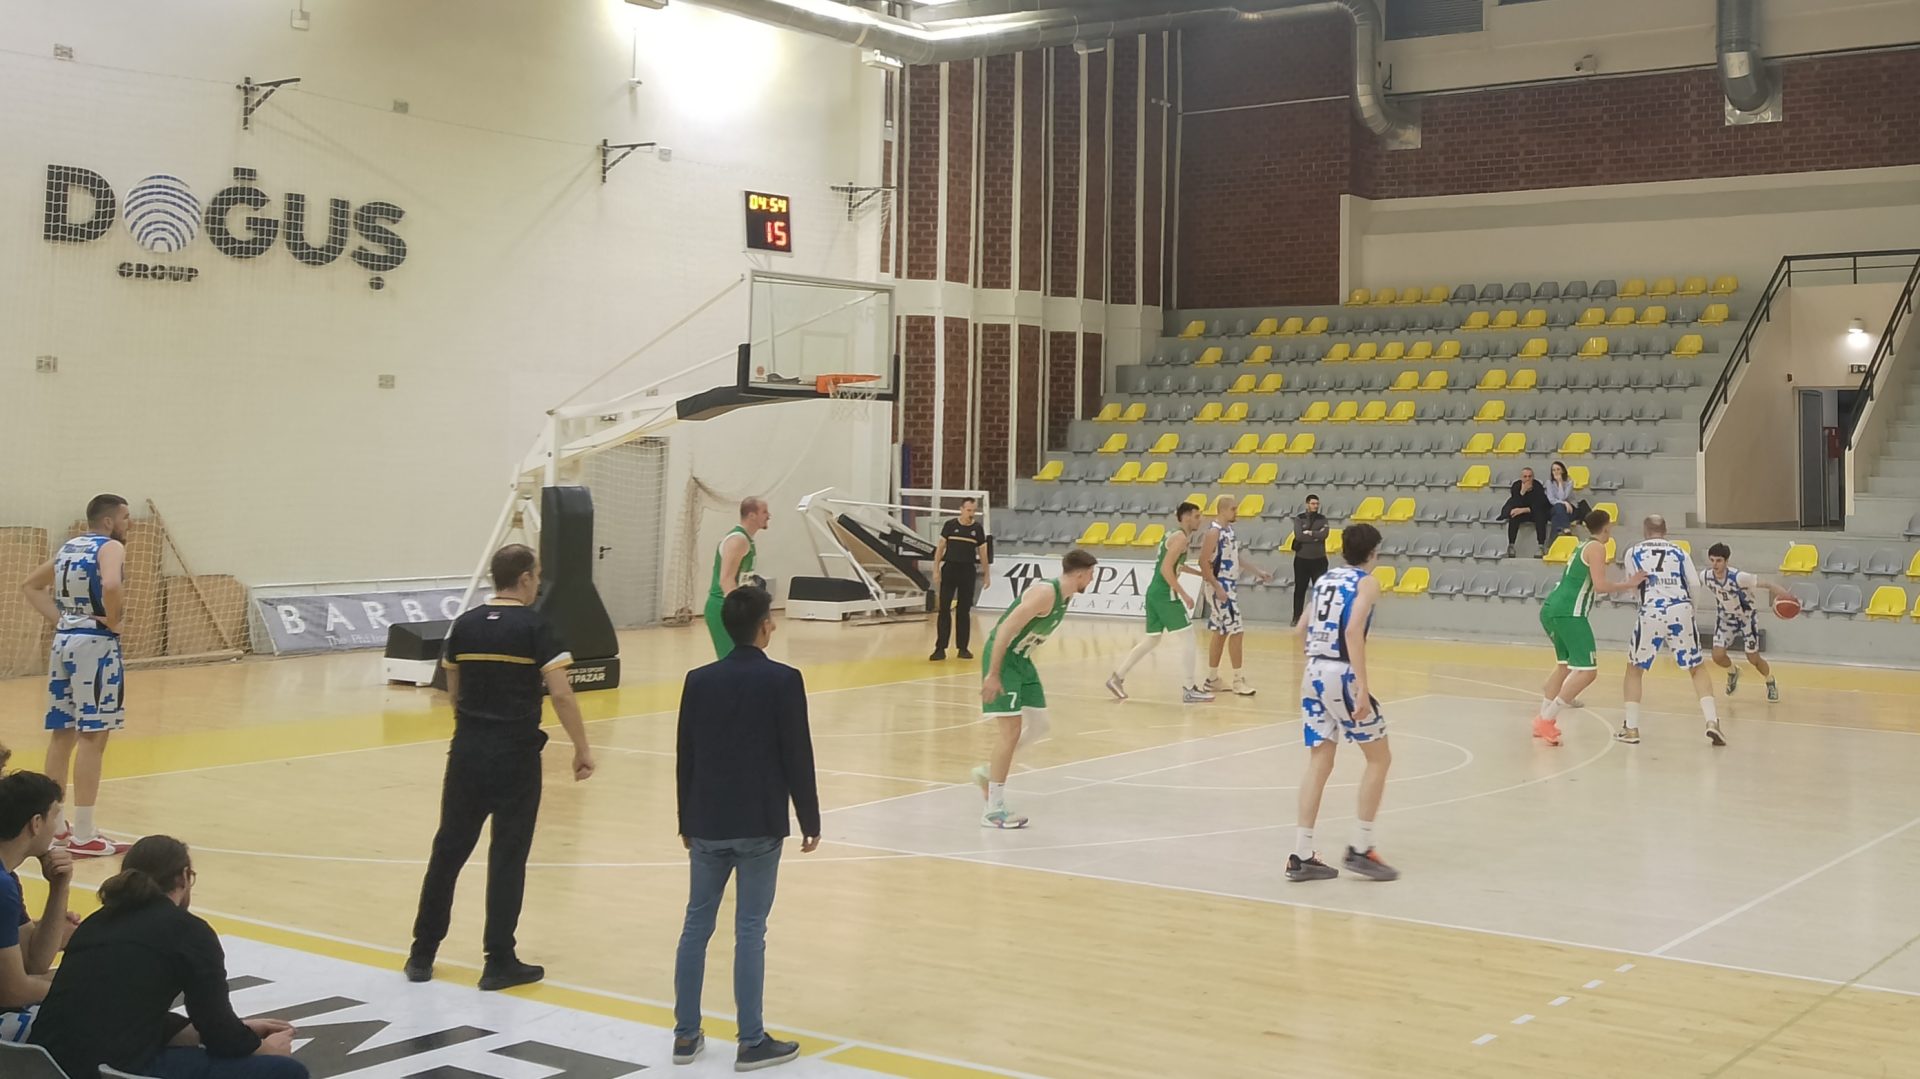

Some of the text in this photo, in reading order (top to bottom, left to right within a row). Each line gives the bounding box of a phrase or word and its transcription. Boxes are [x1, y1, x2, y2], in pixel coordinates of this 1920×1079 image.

[44, 164, 408, 291] DOĞUŞ
[766, 221, 787, 246] 15
[117, 262, 200, 282] GROUP
[1651, 549, 1667, 573] 7
[1090, 566, 1144, 597] PA
[574, 673, 606, 684] PAZAR
[1007, 691, 1018, 709] 7
